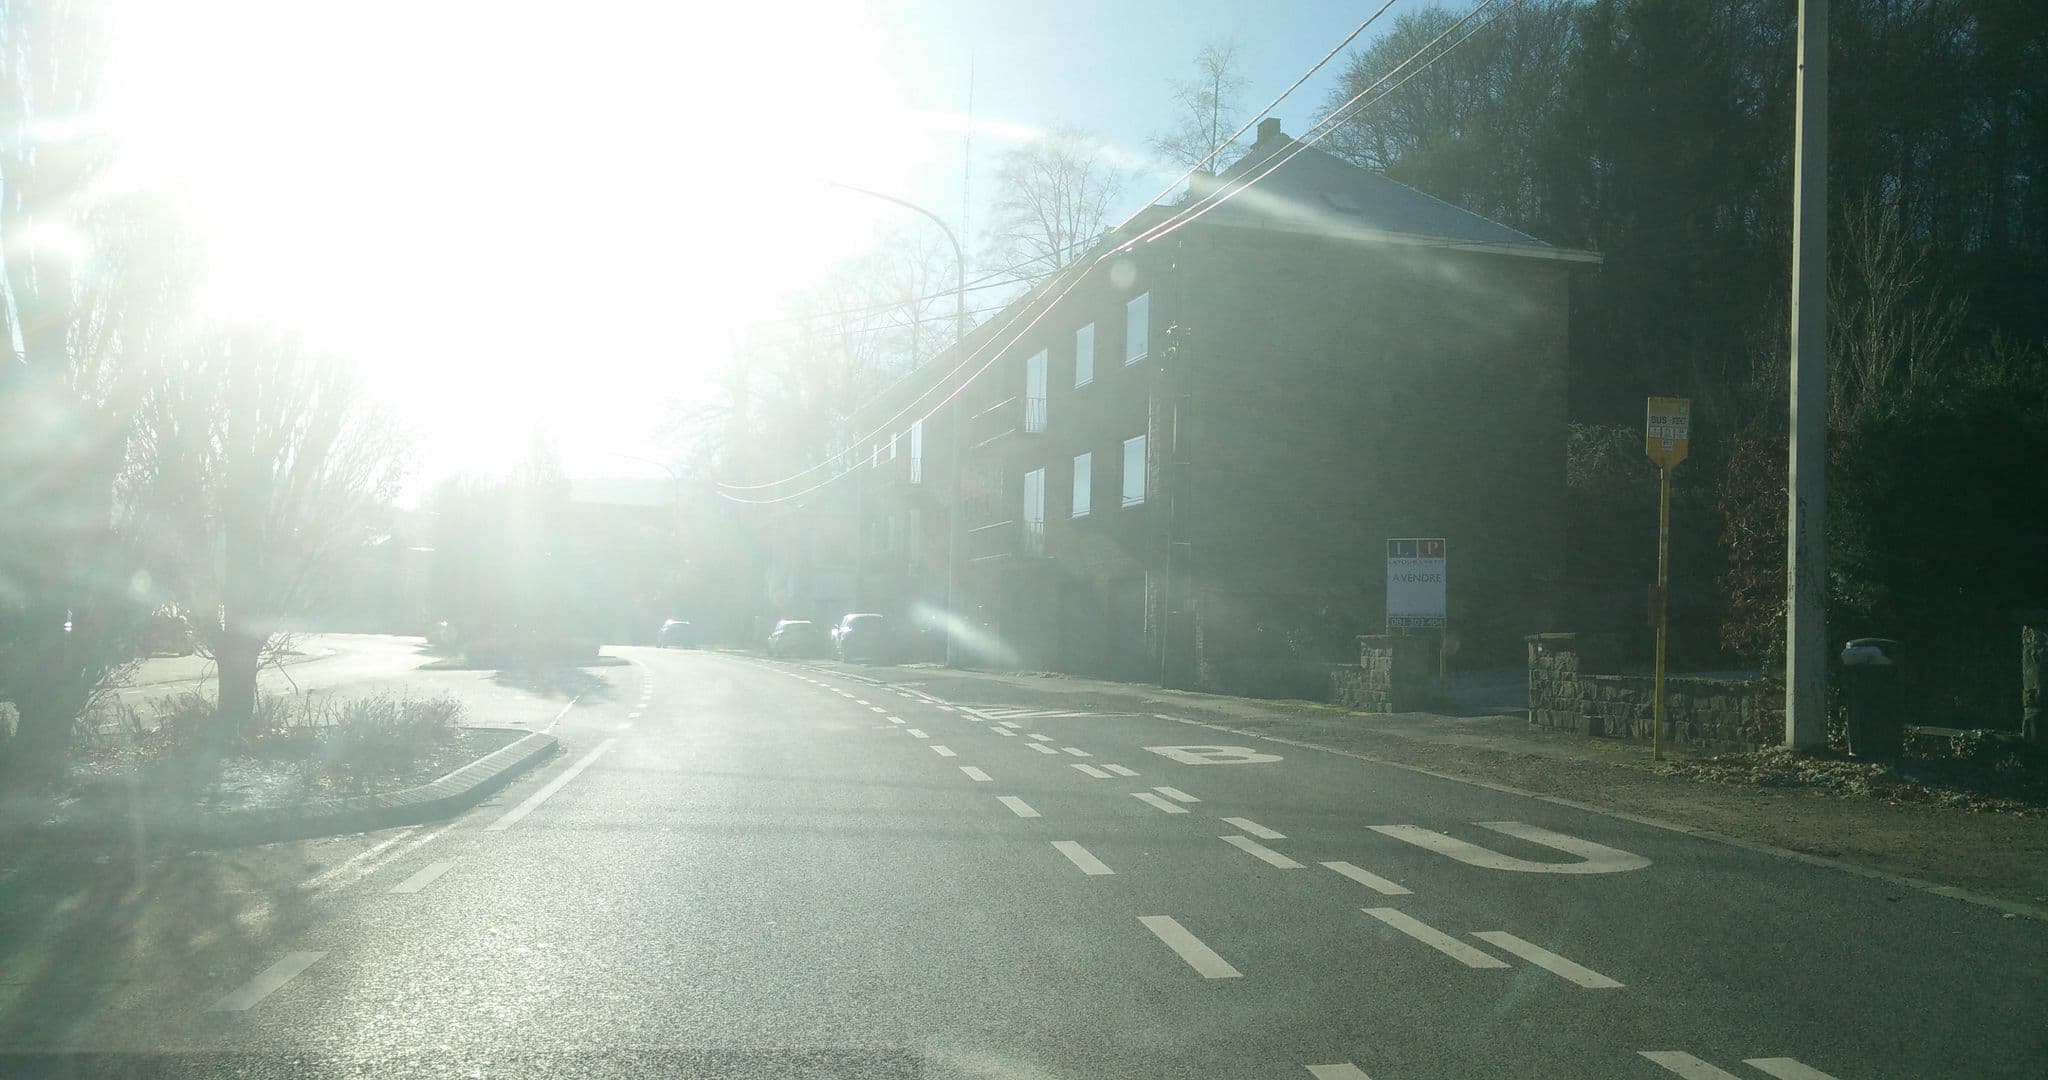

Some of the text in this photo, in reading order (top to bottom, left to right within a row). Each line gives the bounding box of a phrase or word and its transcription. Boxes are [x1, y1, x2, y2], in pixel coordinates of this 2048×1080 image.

[1651, 415, 1667, 424] BUS
[1391, 541, 1439, 555] L P
[1401, 573, 1442, 582] VENDRE
[1142, 745, 1283, 765] B
[1365, 821, 1653, 874] U
